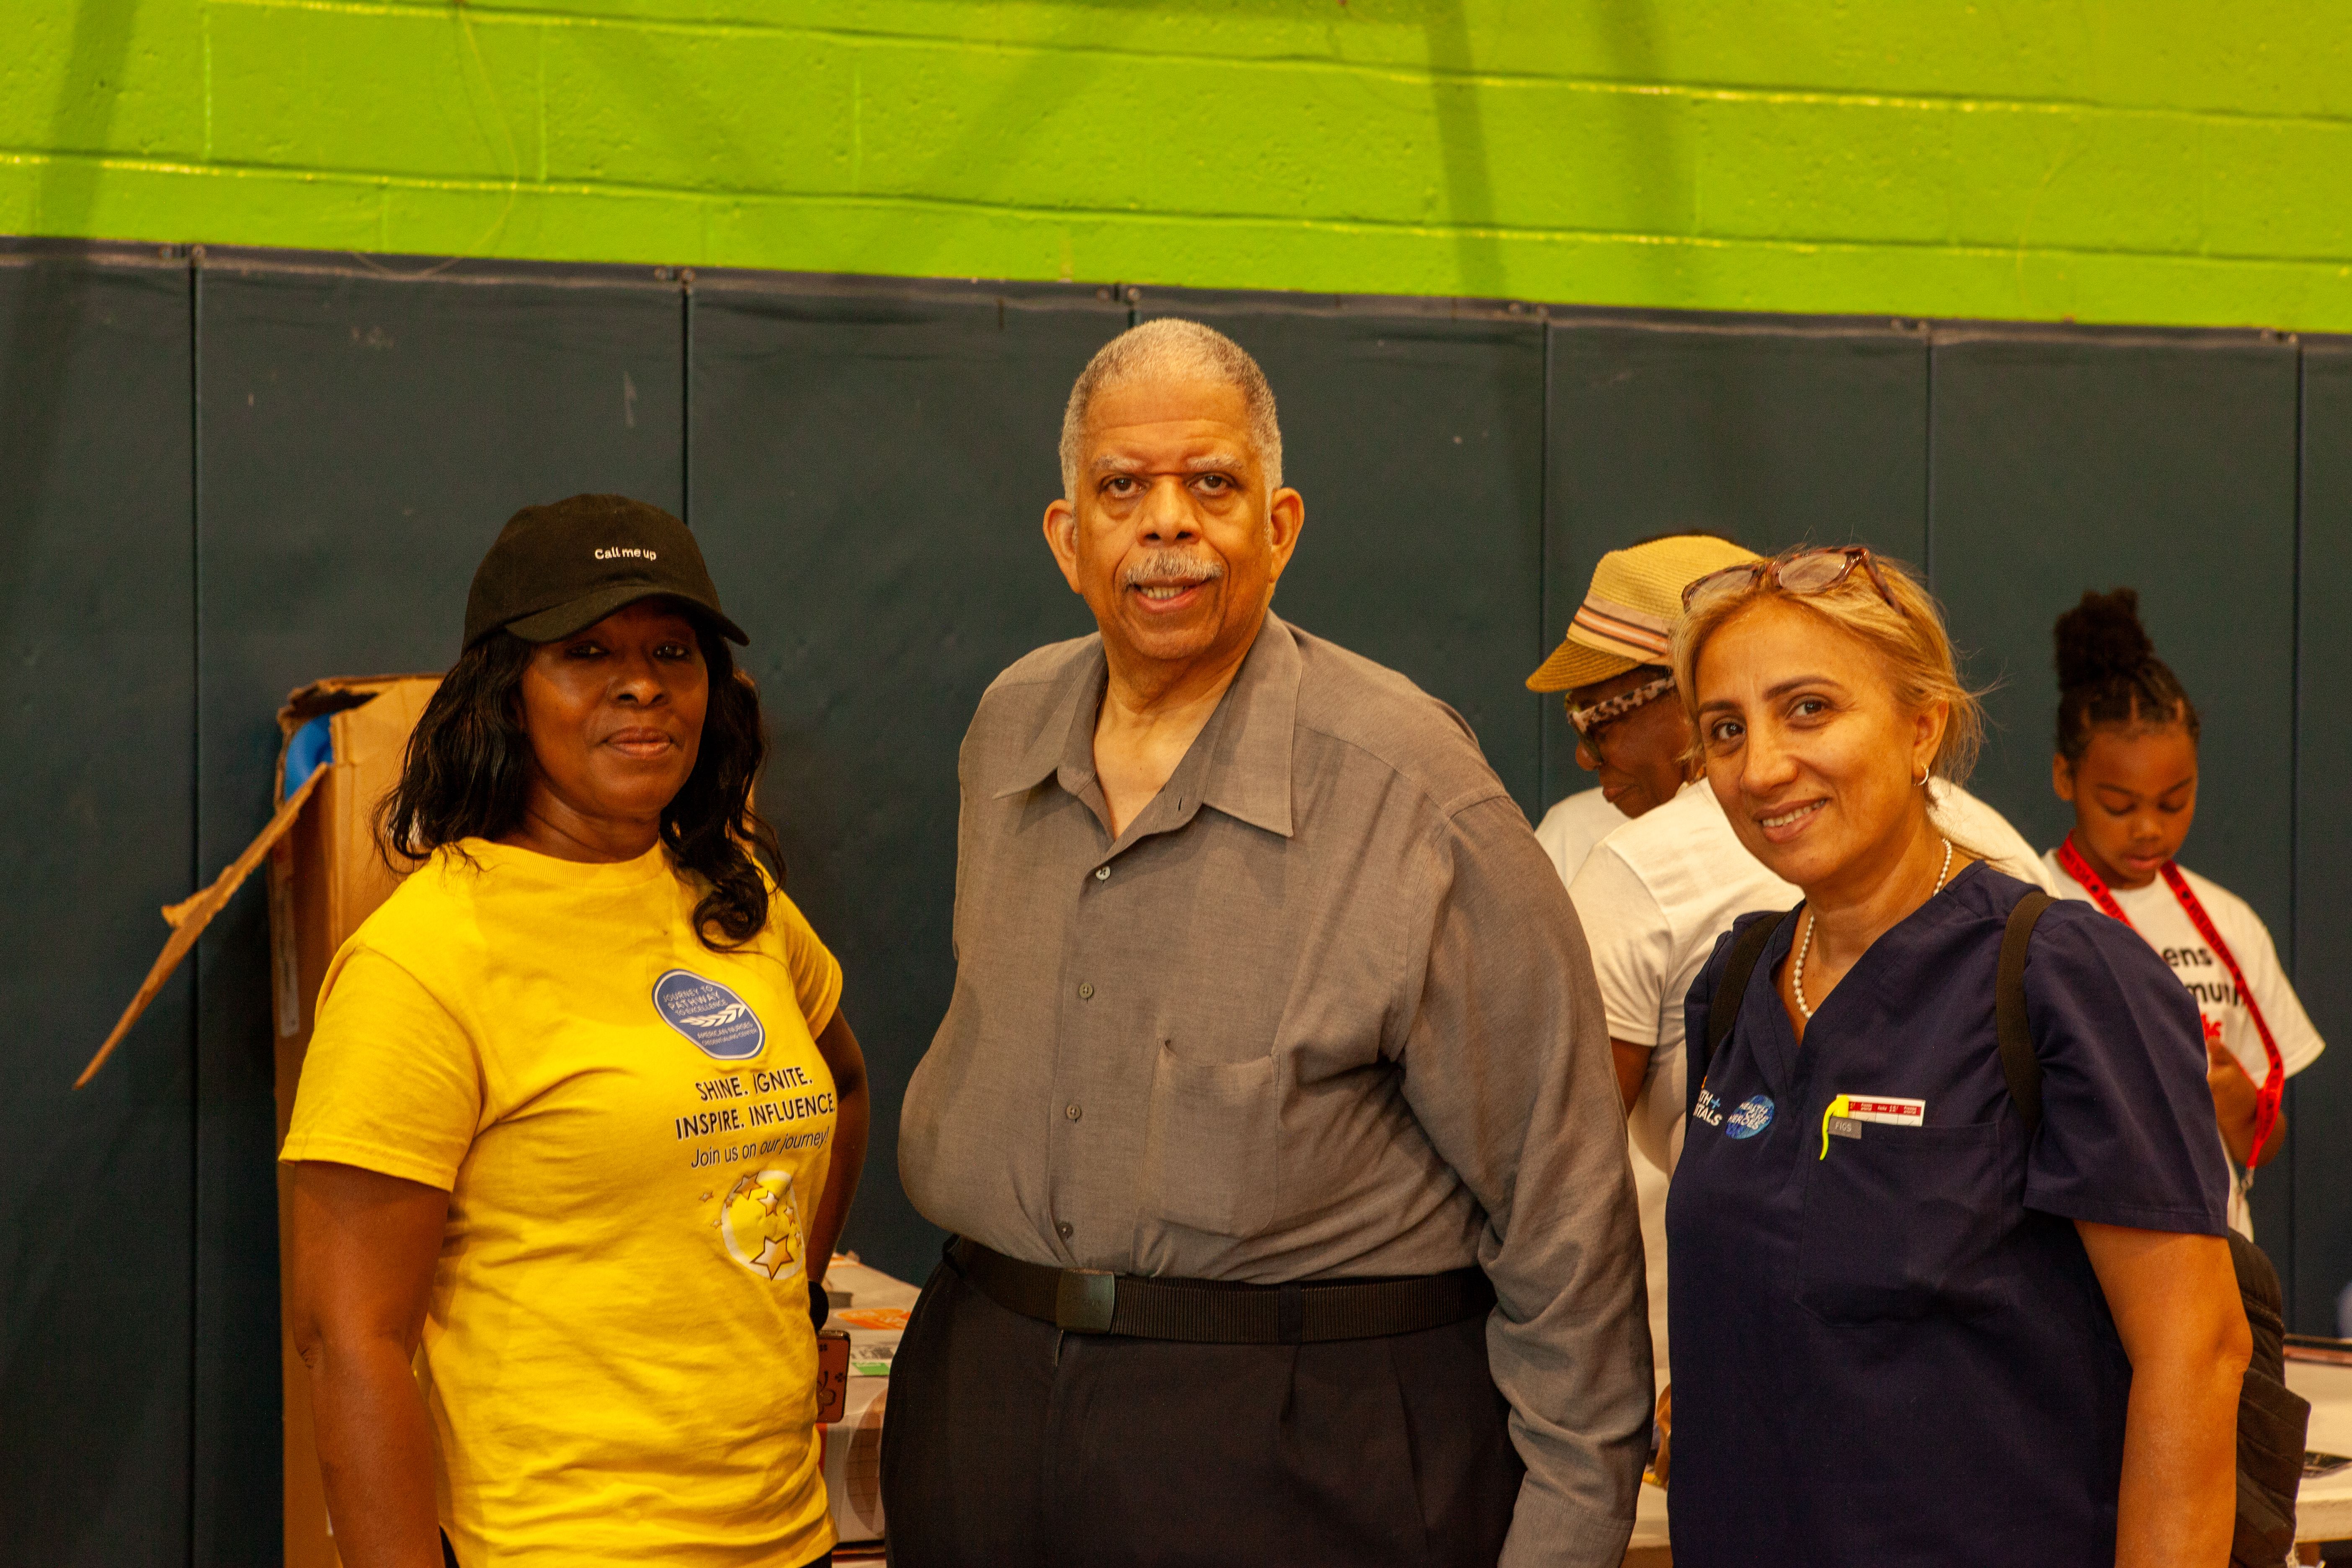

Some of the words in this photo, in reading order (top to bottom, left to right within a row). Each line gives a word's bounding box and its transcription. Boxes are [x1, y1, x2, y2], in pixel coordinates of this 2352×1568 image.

[595, 546, 621, 560] Call
[622, 548, 641, 557] me
[643, 549, 657, 561] up
[663, 988, 699, 1003] JOURNEY
[700, 985, 713, 993] TO
[668, 990, 720, 1011] PATHWAY
[695, 1076, 749, 1103] SHINE.
[753, 1066, 813, 1095] IGNITE.
[675, 1109, 745, 1140] INSPIRE.
[748, 1092, 835, 1127] INFLUENCE.
[1727, 1114, 1759, 1130] HEROES
[1835, 1122, 1852, 1132] FIGS
[691, 1145, 721, 1169] Join
[725, 1147, 739, 1162] us
[742, 1145, 757, 1161] on
[760, 1137, 781, 1155] our
[779, 1126, 830, 1155] journey!
